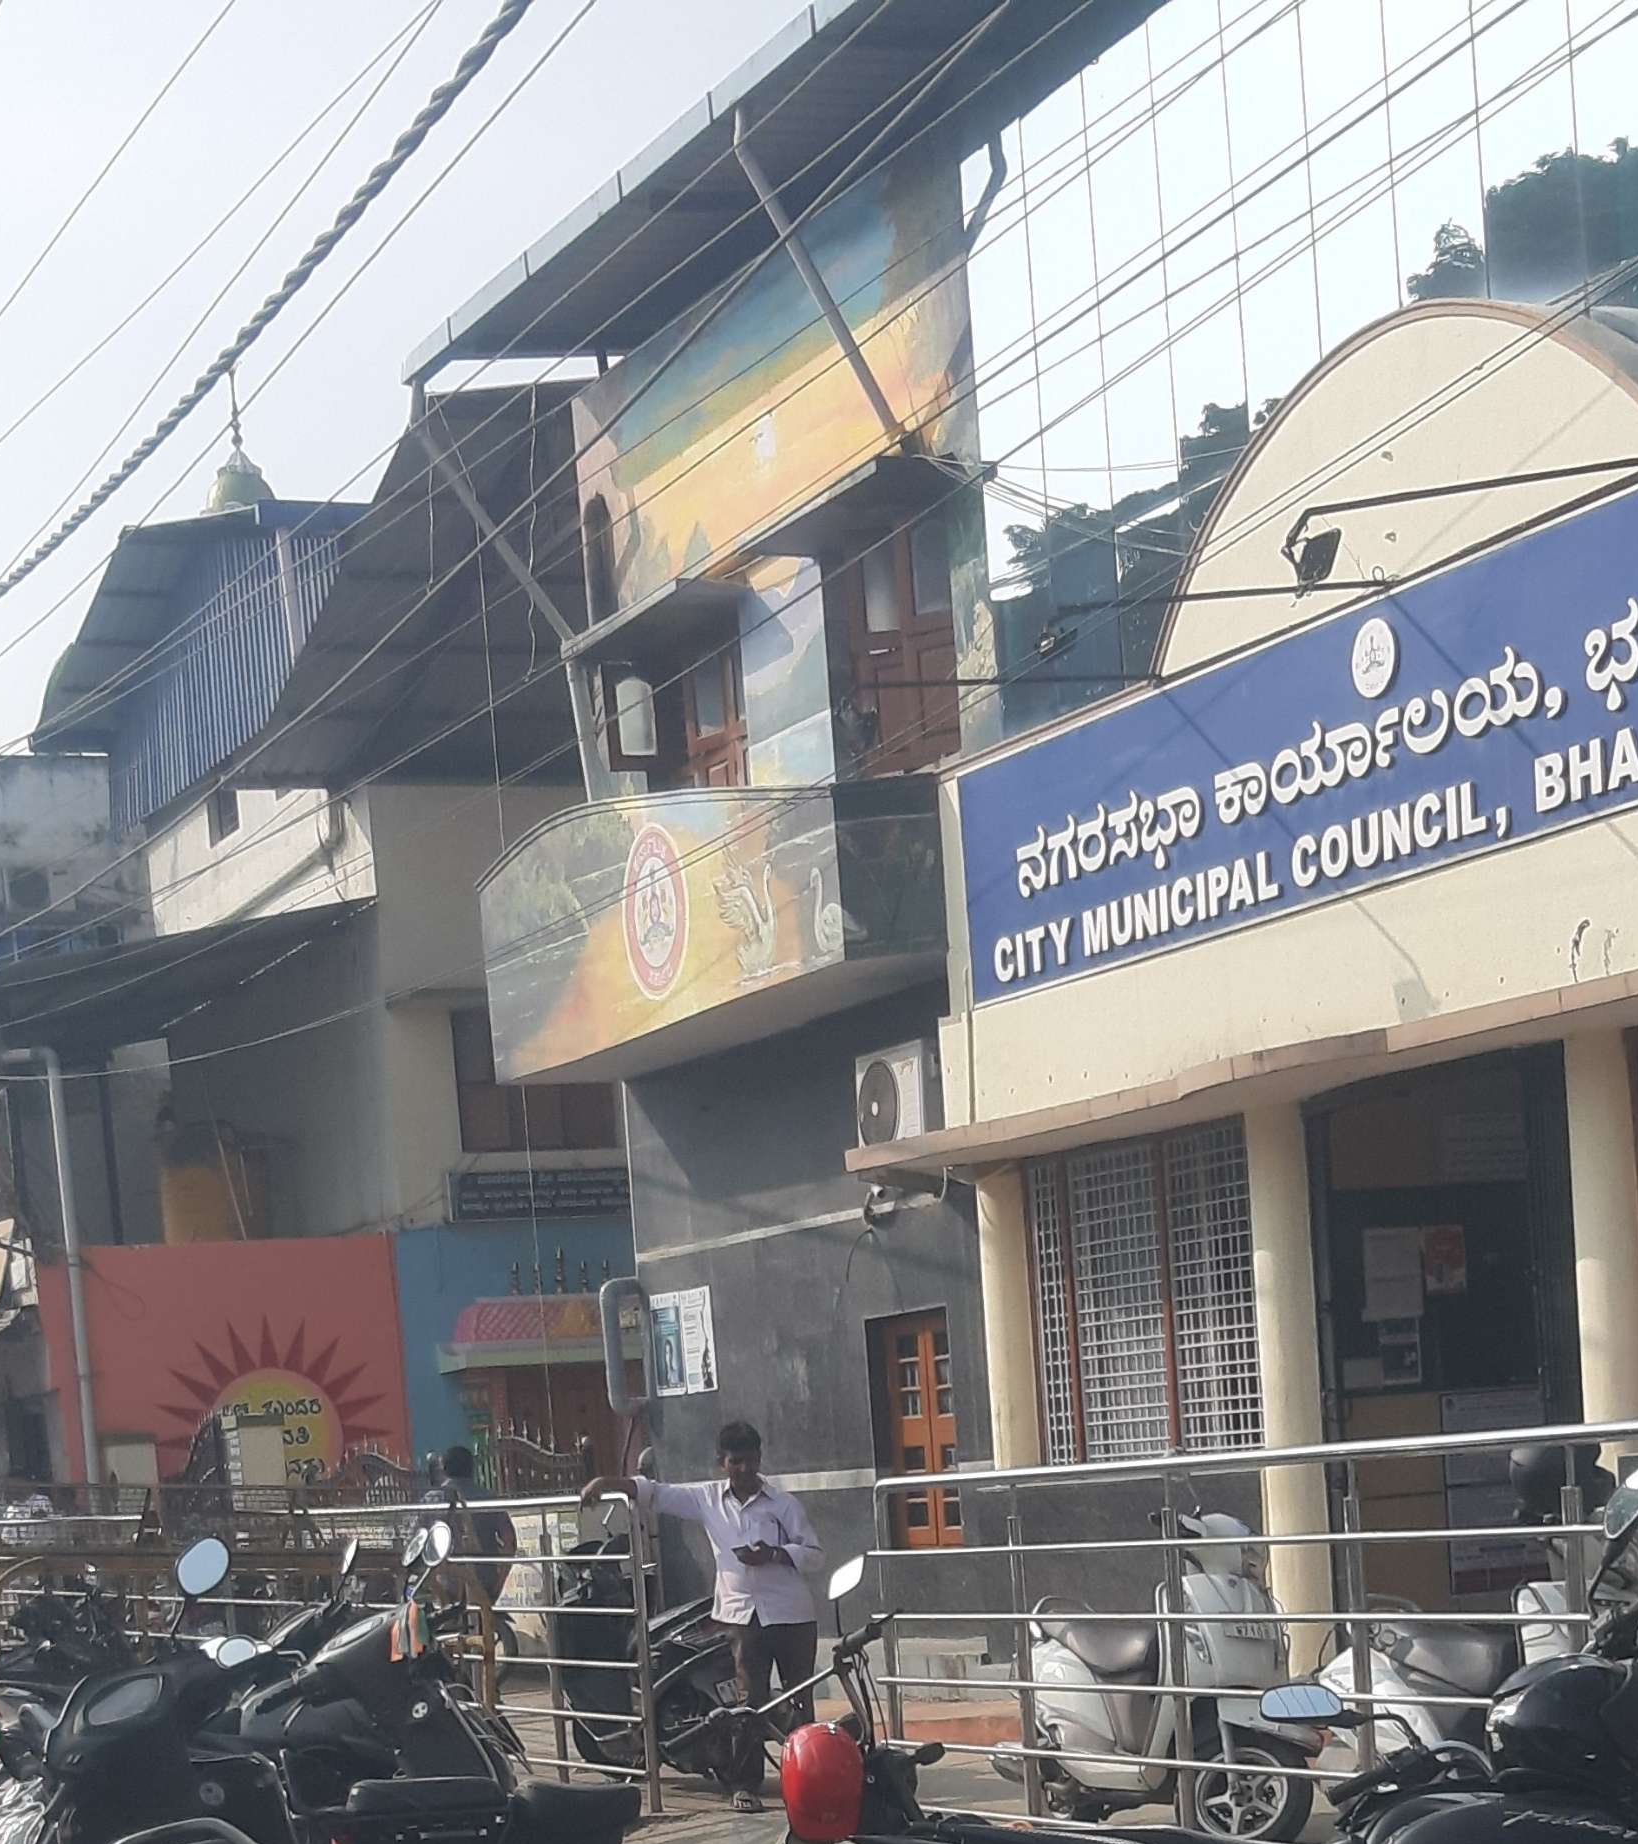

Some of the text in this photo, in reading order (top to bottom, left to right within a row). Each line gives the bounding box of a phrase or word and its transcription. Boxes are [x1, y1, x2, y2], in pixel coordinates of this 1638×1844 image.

[993, 918, 1070, 983] CITY
[1082, 851, 1280, 956] MUNICIPAL
[1291, 781, 1510, 889] COUNCIL,
[1016, 785, 1200, 898] ನಗರಸಭಾ
[1213, 646, 1563, 825] ಕಾರ್ಯಾಲಯ,
